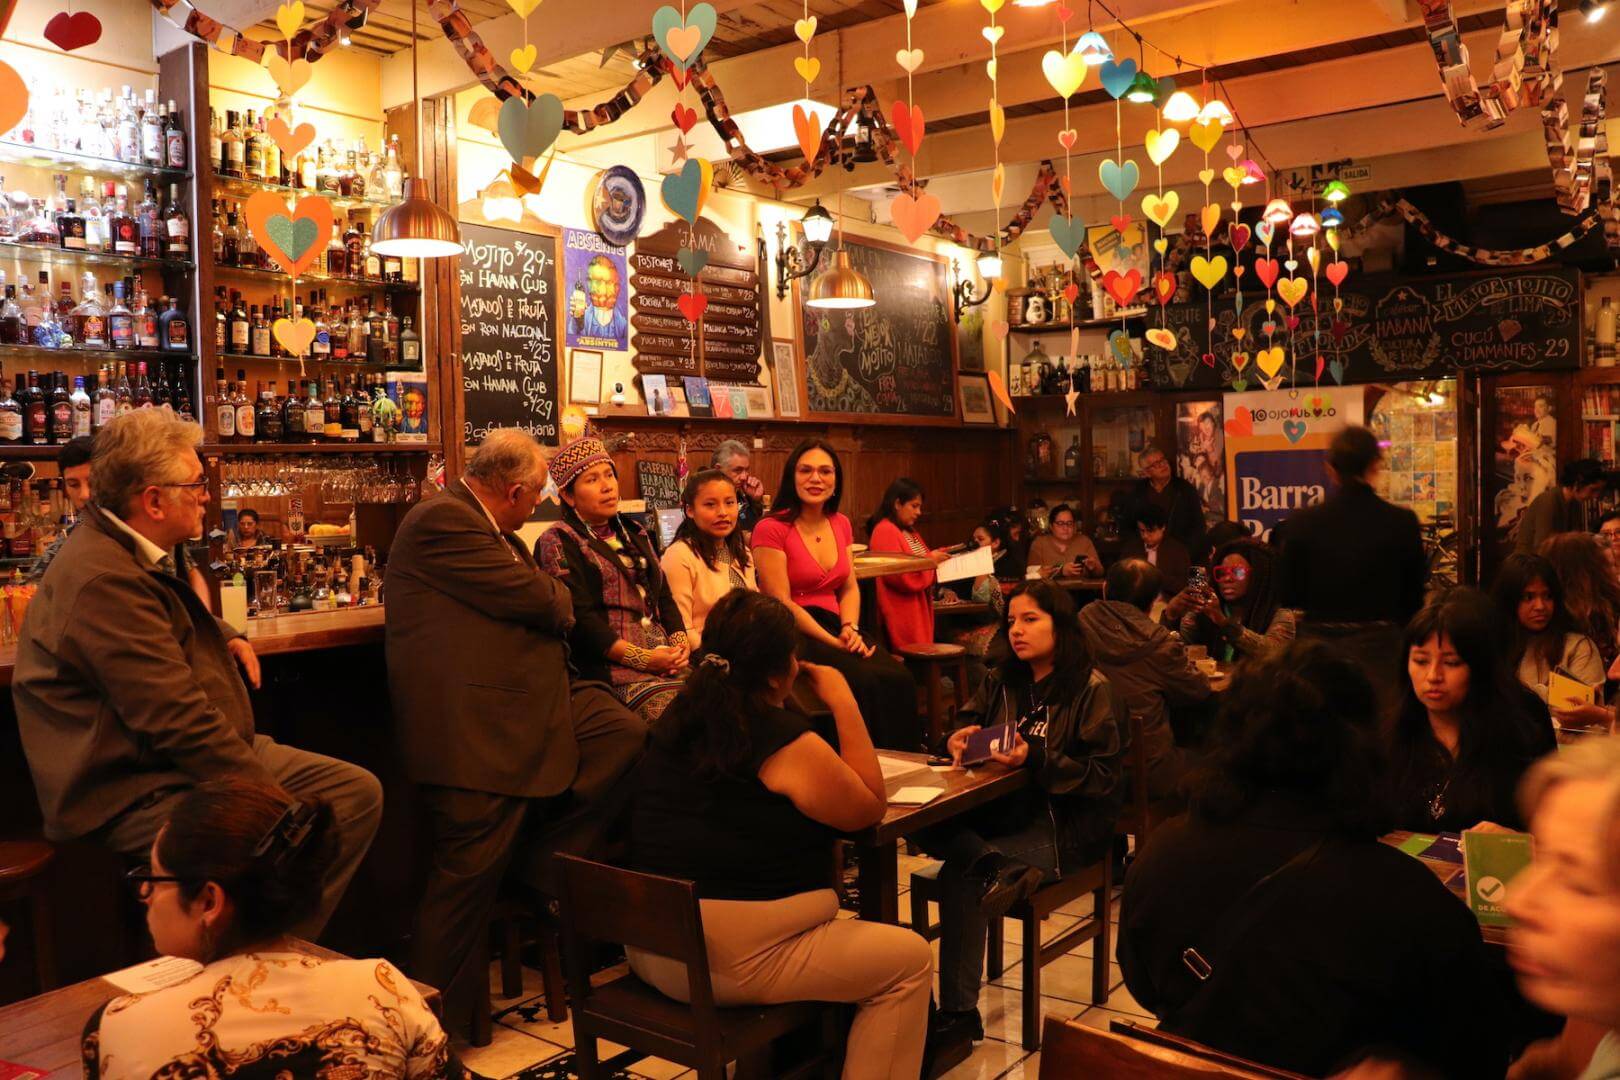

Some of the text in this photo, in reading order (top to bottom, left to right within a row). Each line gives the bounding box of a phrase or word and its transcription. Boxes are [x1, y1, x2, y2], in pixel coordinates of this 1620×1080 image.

[1344, 168, 1369, 179] SALIDA
[461, 239, 513, 273] MOJITO
[636, 255, 673, 272] TOSTONES
[478, 270, 519, 289] HAVANA
[521, 273, 547, 294] CLUB
[1436, 281, 1452, 301] EL
[1507, 279, 1569, 299] MOJITO
[461, 295, 503, 320] MAJADOS
[517, 298, 548, 320] FRUTA
[1446, 280, 1501, 318] MEJOR
[1508, 297, 1545, 313] LIMA
[480, 322, 498, 336] RON
[502, 321, 551, 341] NACIONAL
[1376, 315, 1433, 337] HABANA
[640, 335, 655, 345] YUCA
[657, 337, 674, 348] FRITA
[1544, 338, 1570, 357] 29
[462, 350, 503, 371] MAJADOS
[514, 355, 542, 377] FRUTA
[862, 349, 894, 373] MOJITO
[482, 375, 519, 393] HAVANA
[523, 377, 546, 397] CLUB
[1240, 477, 1325, 510] Barra
